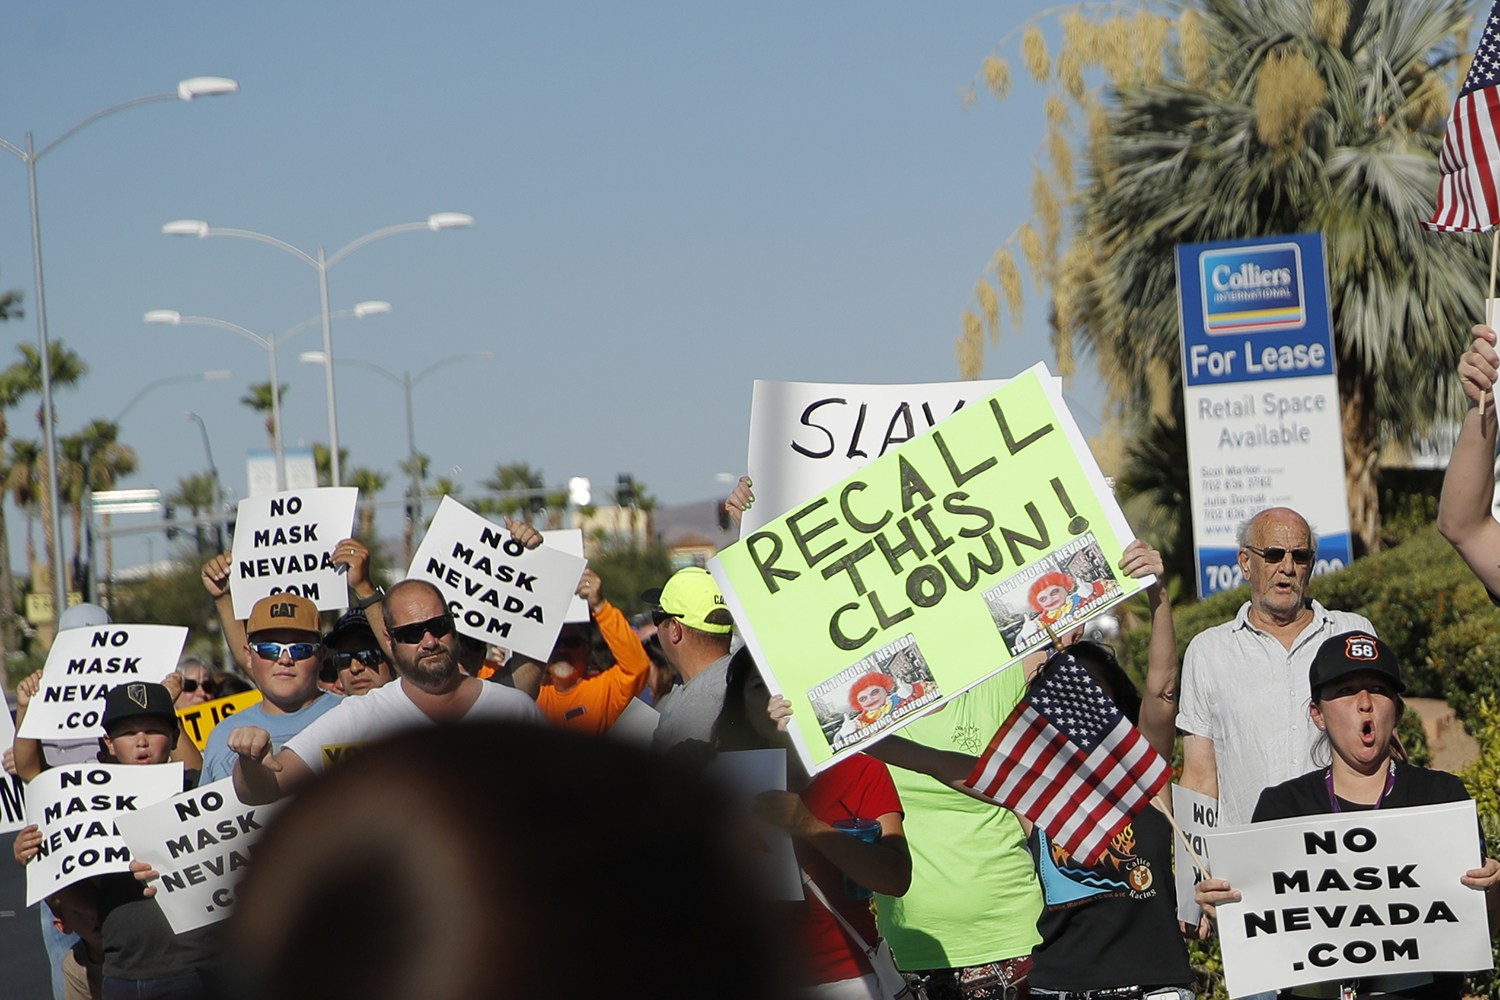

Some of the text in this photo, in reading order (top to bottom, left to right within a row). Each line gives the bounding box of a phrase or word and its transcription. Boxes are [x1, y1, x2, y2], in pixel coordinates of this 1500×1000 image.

[1211, 262, 1291, 291] Colliers
[1214, 286, 1291, 303] INTERNATIONAL
[1190, 341, 1326, 377] For Lease
[1198, 392, 1326, 420] Retail Space
[1217, 423, 1312, 449] Available
[271, 496, 302, 517] NO
[747, 398, 1054, 595] RECALL
[254, 523, 318, 548] MASK
[480, 527, 524, 557] NO
[821, 491, 996, 597] THIS
[240, 551, 334, 579] NEVADA
[451, 542, 539, 593] MASK
[828, 477, 1091, 651] CLOWN!
[985, 532, 1096, 602] DON'T WORRY NEVADA
[426, 557, 545, 625] NEVADA
[714, 594, 727, 606] CA
[270, 603, 299, 618] CAT
[448, 600, 512, 639] COM
[1010, 586, 1122, 656] I'M FOLLWING CALIFORNIA
[91, 631, 129, 647] NO
[1352, 644, 1373, 657] 58
[67, 657, 142, 675] MASK
[808, 634, 916, 701] DON'T WORRY NEVADA
[44, 684, 120, 702] NEVA
[58, 711, 99, 730] .CO
[830, 688, 942, 754] I'M FOLLOWING CALIFORNIA
[60, 770, 112, 788] NO
[44, 795, 138, 826] MASK
[175, 791, 223, 822] NO
[37, 820, 120, 862] NEVA
[166, 810, 263, 859] MASK
[1303, 827, 1378, 856] NO
[55, 847, 130, 880] .COM
[161, 845, 252, 893] NEVA
[1125, 858, 1151, 871] Calico
[1128, 888, 1157, 900] Racing
[1272, 863, 1422, 896] MASK
[205, 888, 233, 913] .C
[1243, 900, 1460, 938] NEVADA
[1293, 938, 1420, 972] .COM
